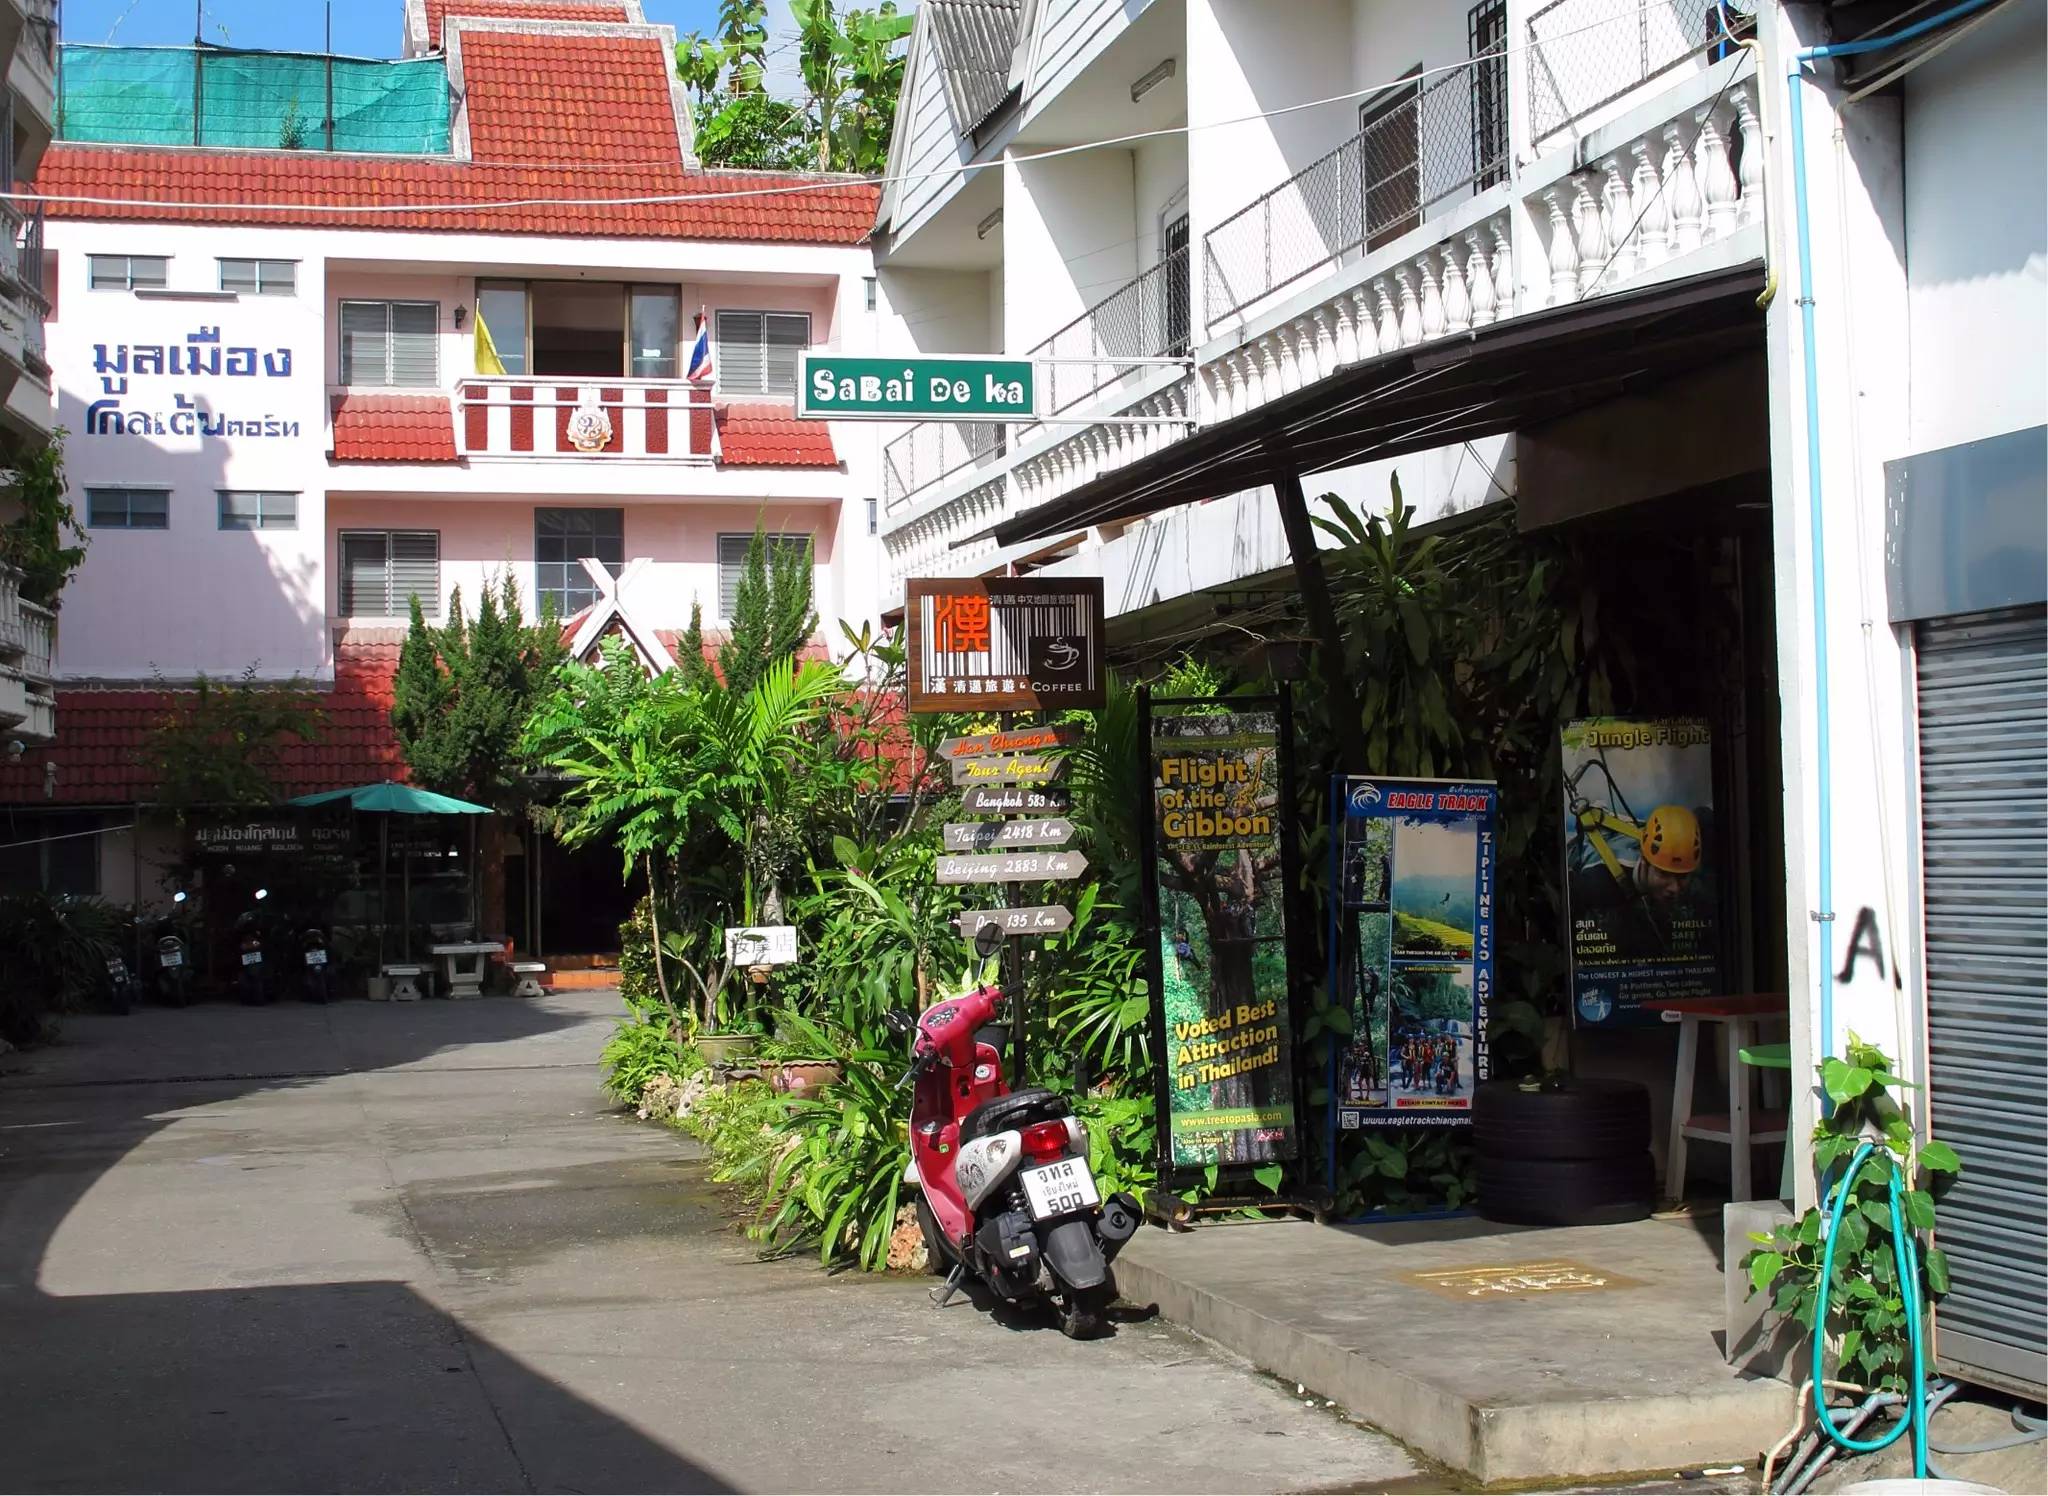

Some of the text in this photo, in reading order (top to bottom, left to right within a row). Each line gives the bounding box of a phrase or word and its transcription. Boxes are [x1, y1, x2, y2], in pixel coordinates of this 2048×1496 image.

[93, 326, 292, 395] มูลเมือง
[1589, 727, 1710, 750] Jungle Flight
[1161, 756, 1249, 788] Flight
[975, 791, 1023, 812] Bangkok
[1027, 794, 1045, 807] 583
[1162, 788, 1227, 809] of the
[1387, 791, 1489, 811] EAGLE TRACK
[954, 821, 1062, 845] Taipei 2418 Km
[1162, 810, 1271, 838] Gibbon
[945, 855, 1069, 879] Beijing 2883 Km
[1007, 914, 1028, 928] 135
[1034, 911, 1056, 927] Km
[1477, 832, 1492, 1081] ZIPLINE ECO ADVENTURE
[1174, 999, 1276, 1042] Voted Best
[1176, 1024, 1278, 1067] Attraction
[1178, 1044, 1279, 1090] in Thailand!
[1180, 1111, 1282, 1128] www.treetopasia.com
[1047, 1192, 1084, 1215] 500
